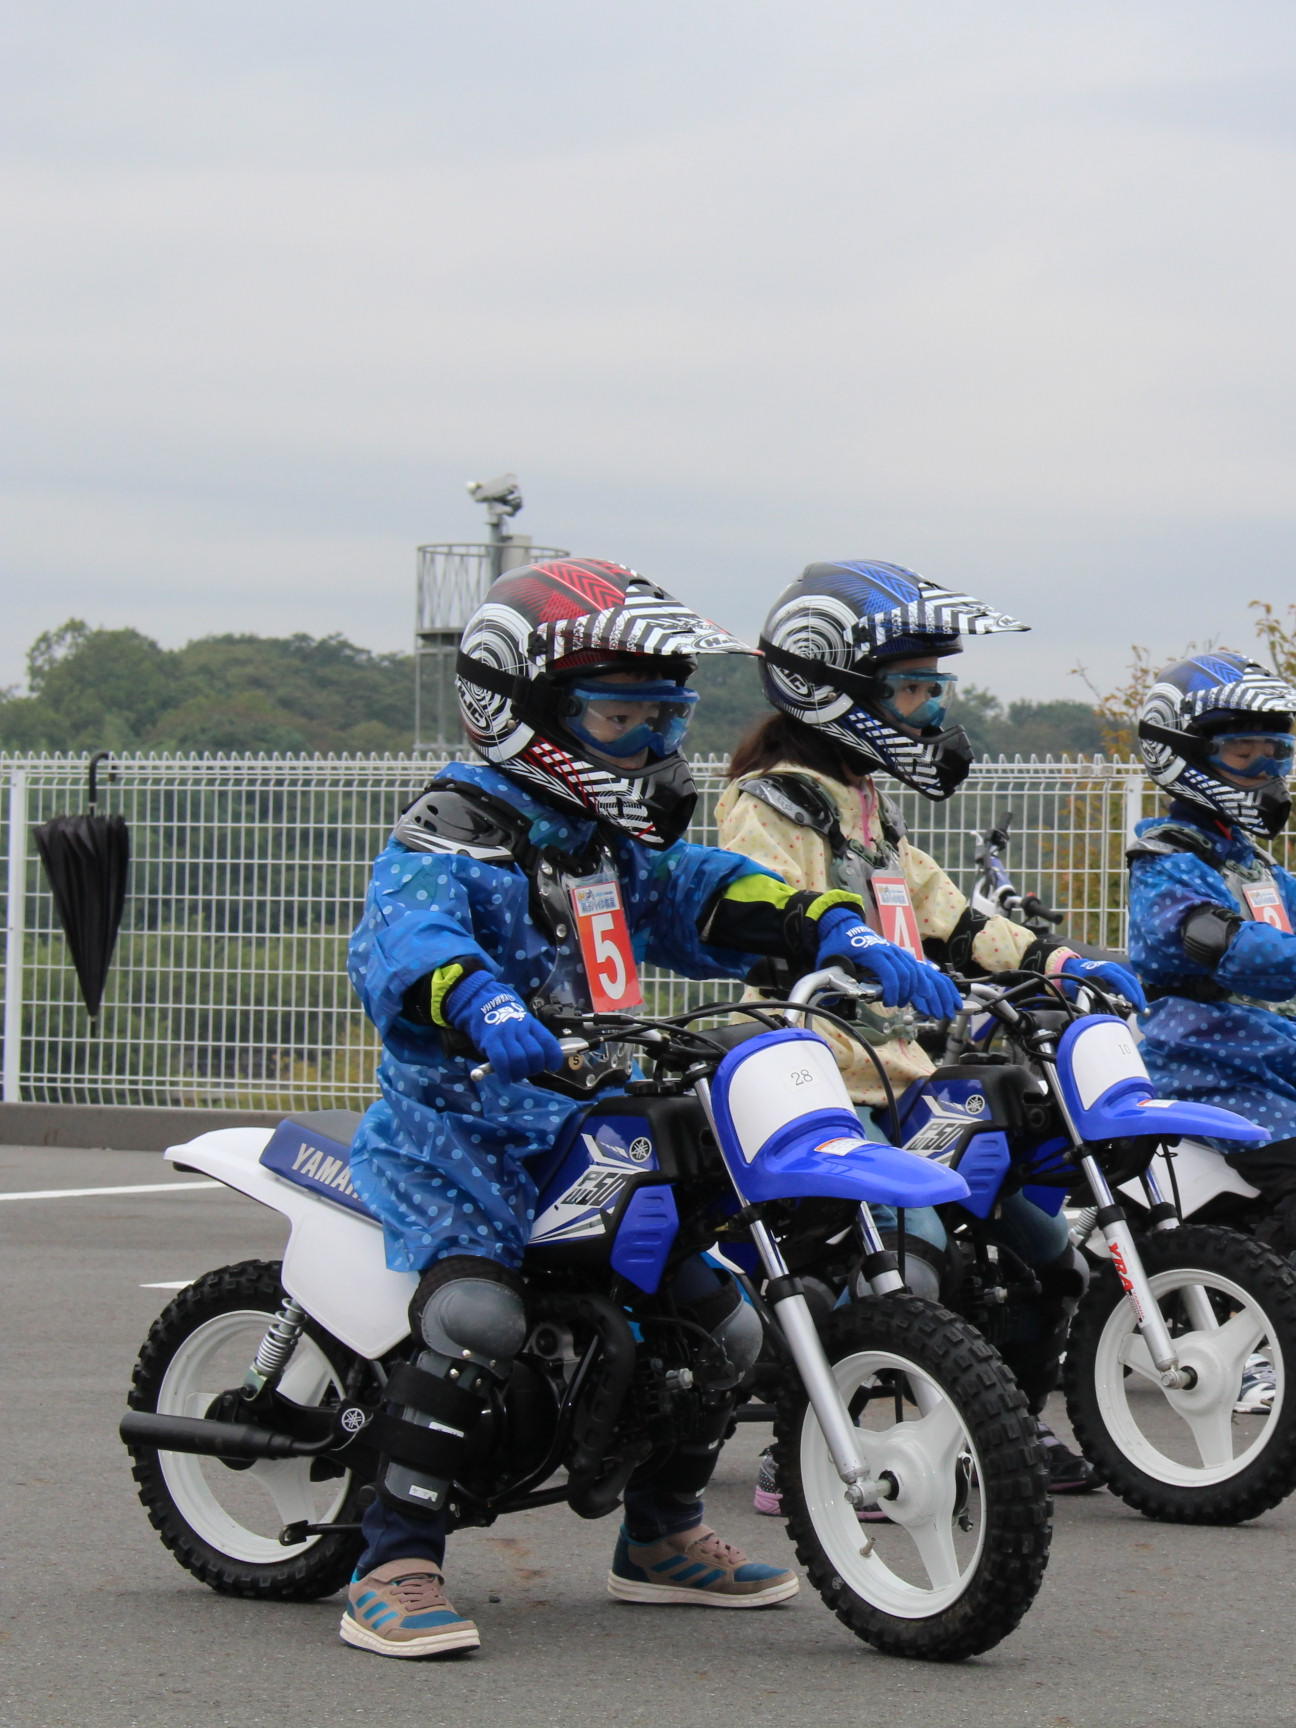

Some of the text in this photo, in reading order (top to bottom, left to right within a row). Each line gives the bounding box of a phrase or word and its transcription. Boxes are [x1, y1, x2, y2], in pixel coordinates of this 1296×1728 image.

[591, 913, 626, 1000] 5
[790, 1069, 813, 1086] 28
[291, 1142, 361, 1201] YAMA
[1108, 1242, 1135, 1293] YRA
